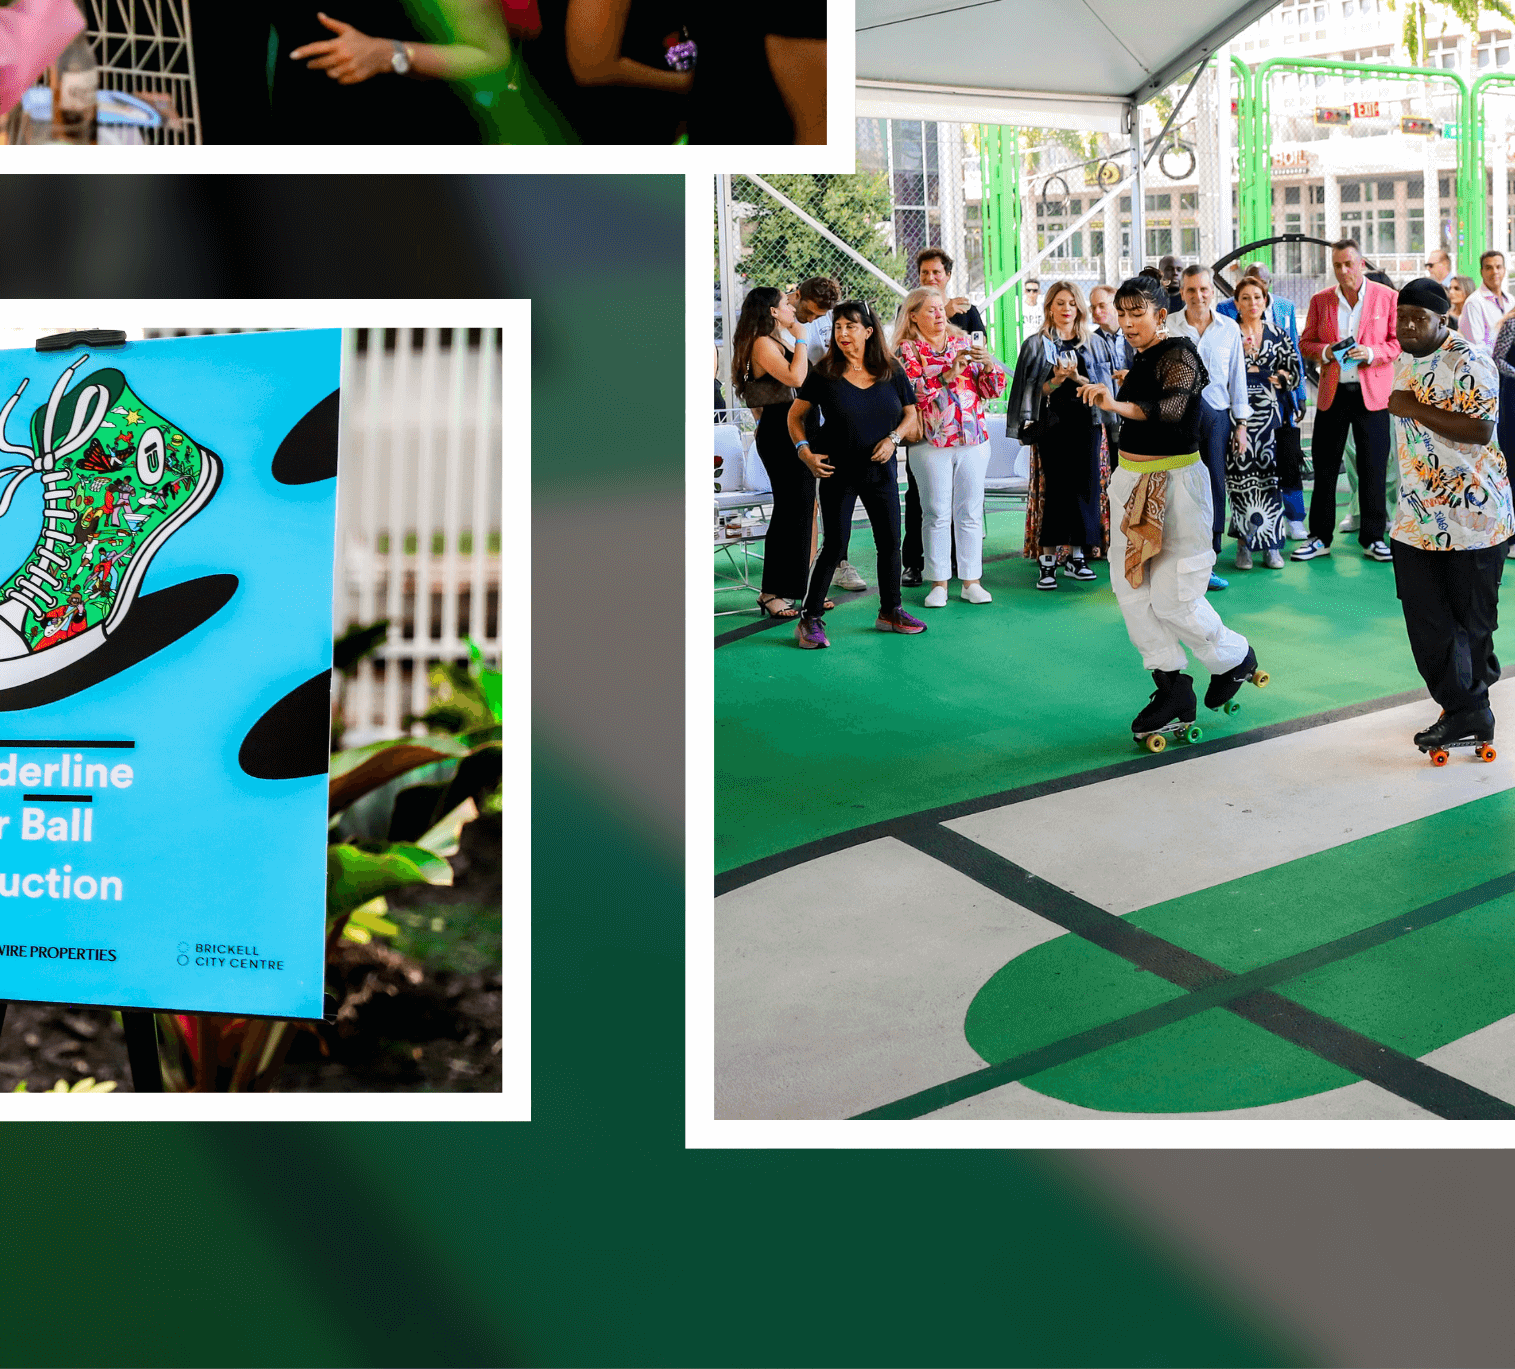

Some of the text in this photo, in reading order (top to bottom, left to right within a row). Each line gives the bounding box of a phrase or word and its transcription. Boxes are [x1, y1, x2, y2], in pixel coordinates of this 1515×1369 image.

[21, 807, 93, 842] Ball
[30, 945, 117, 962] PROPERTIES
[195, 943, 259, 956] BRICKELL
[195, 957, 284, 971] CITY CENTRE
